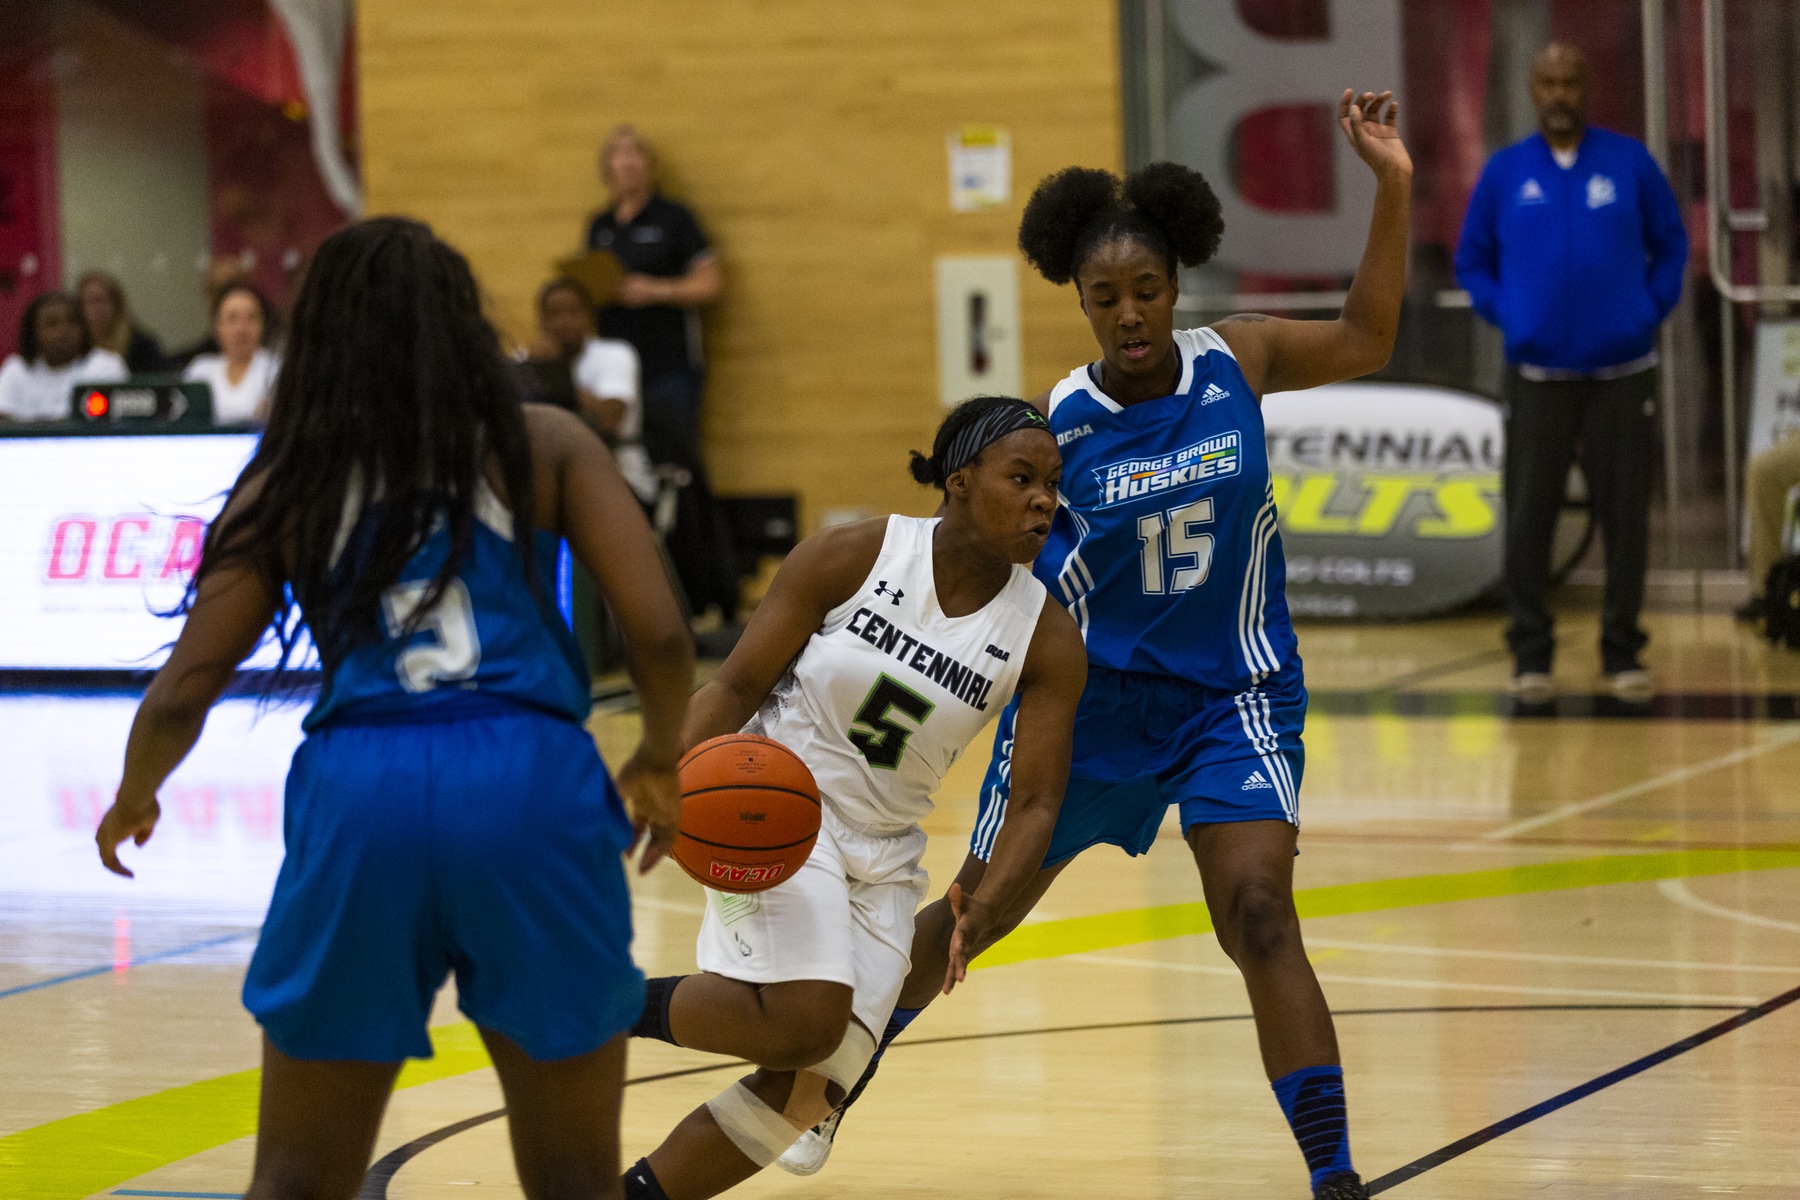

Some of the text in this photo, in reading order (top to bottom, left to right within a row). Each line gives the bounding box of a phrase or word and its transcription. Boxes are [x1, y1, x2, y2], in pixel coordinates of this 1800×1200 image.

[1201, 391, 1230, 406] adidas
[1056, 424, 1094, 447] OCAA
[1106, 434, 1237, 480] GEORGE BROWN
[1105, 456, 1237, 504] HUSKIES
[1137, 497, 1216, 595] 15
[846, 607, 993, 712] CENTENNIAL
[985, 643, 1010, 662] OCAA
[848, 671, 936, 771] 5
[1241, 782, 1273, 791] adidas
[710, 861, 786, 882] OCAA
